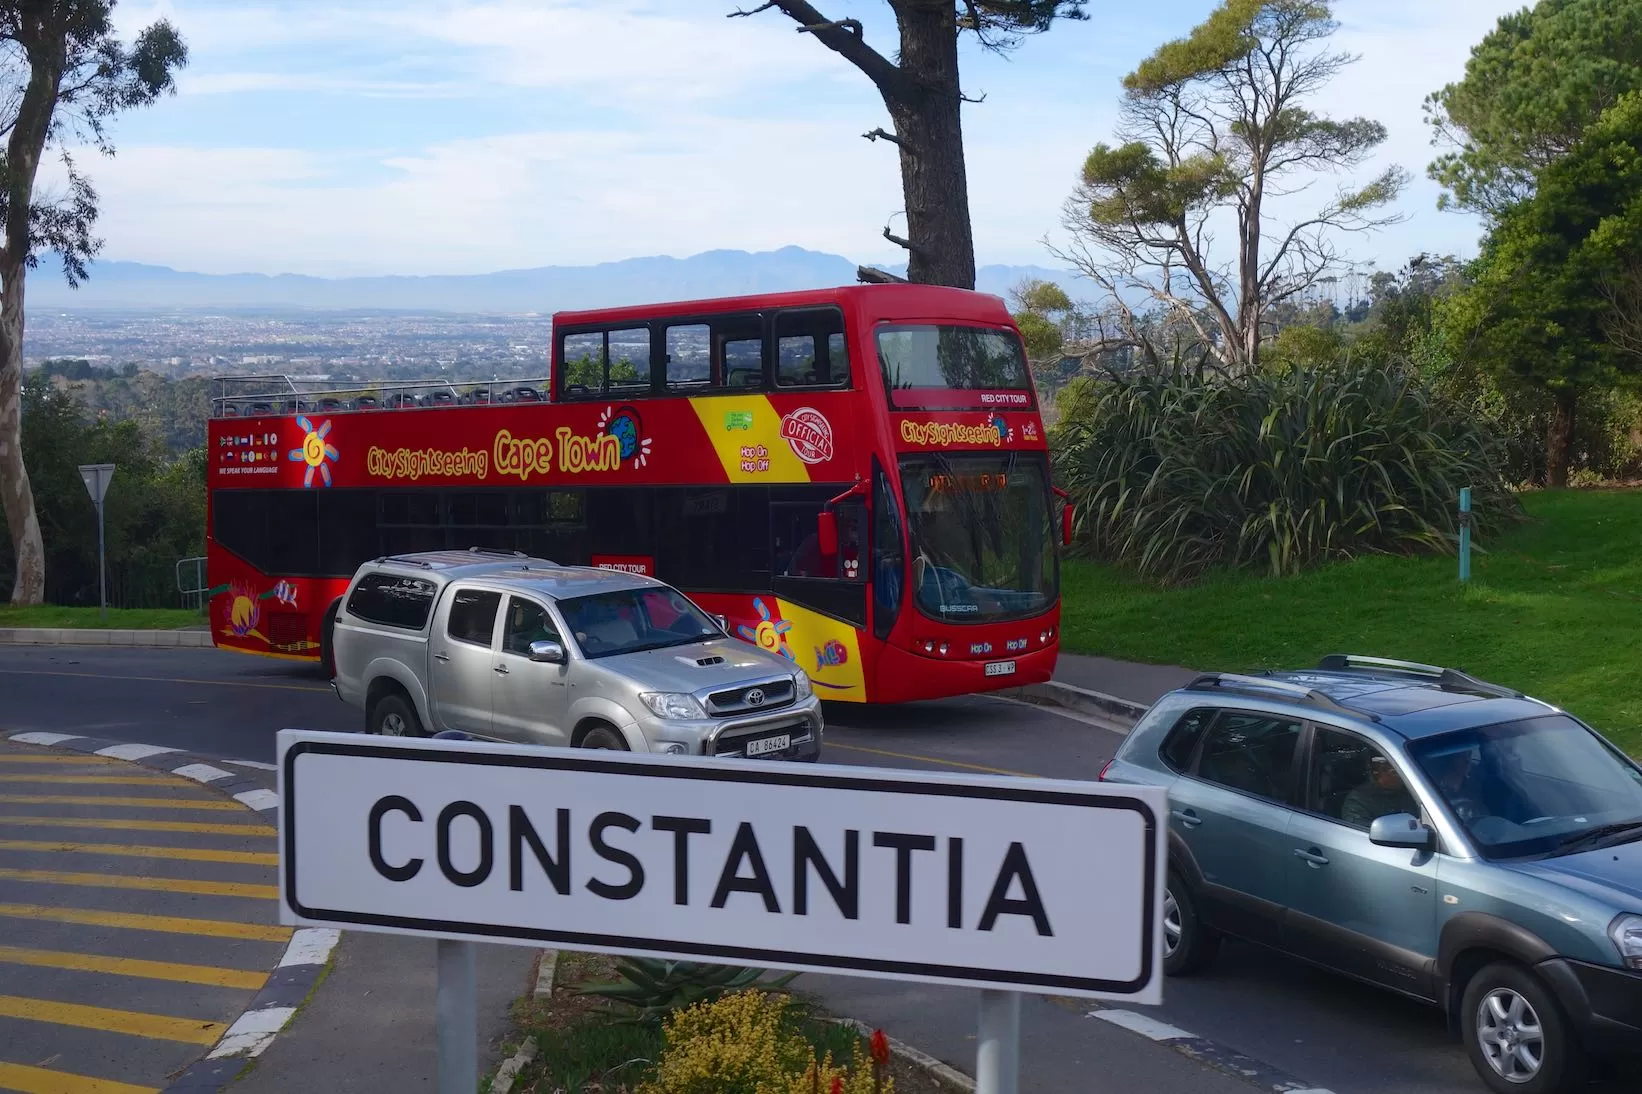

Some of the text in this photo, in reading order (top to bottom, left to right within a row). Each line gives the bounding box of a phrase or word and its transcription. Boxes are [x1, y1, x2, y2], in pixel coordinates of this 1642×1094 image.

[981, 394, 1027, 404] RED CITY TOUR
[788, 420, 828, 454] OFFICIAL
[901, 419, 1001, 447] CitySightseeing
[367, 426, 620, 481] CitySightseeing Cape Town
[741, 445, 768, 458] Hop On
[800, 445, 816, 458] TOUR
[253, 466, 278, 474] LANGUAGE
[741, 459, 769, 472] Hop Off
[613, 564, 627, 572] CITY
[628, 564, 646, 573] TOUR
[971, 642, 993, 654] Hop On
[1006, 638, 1028, 650] Hop Off
[763, 736, 786, 751] 86424
[367, 794, 1054, 937] CONSTANTIA
